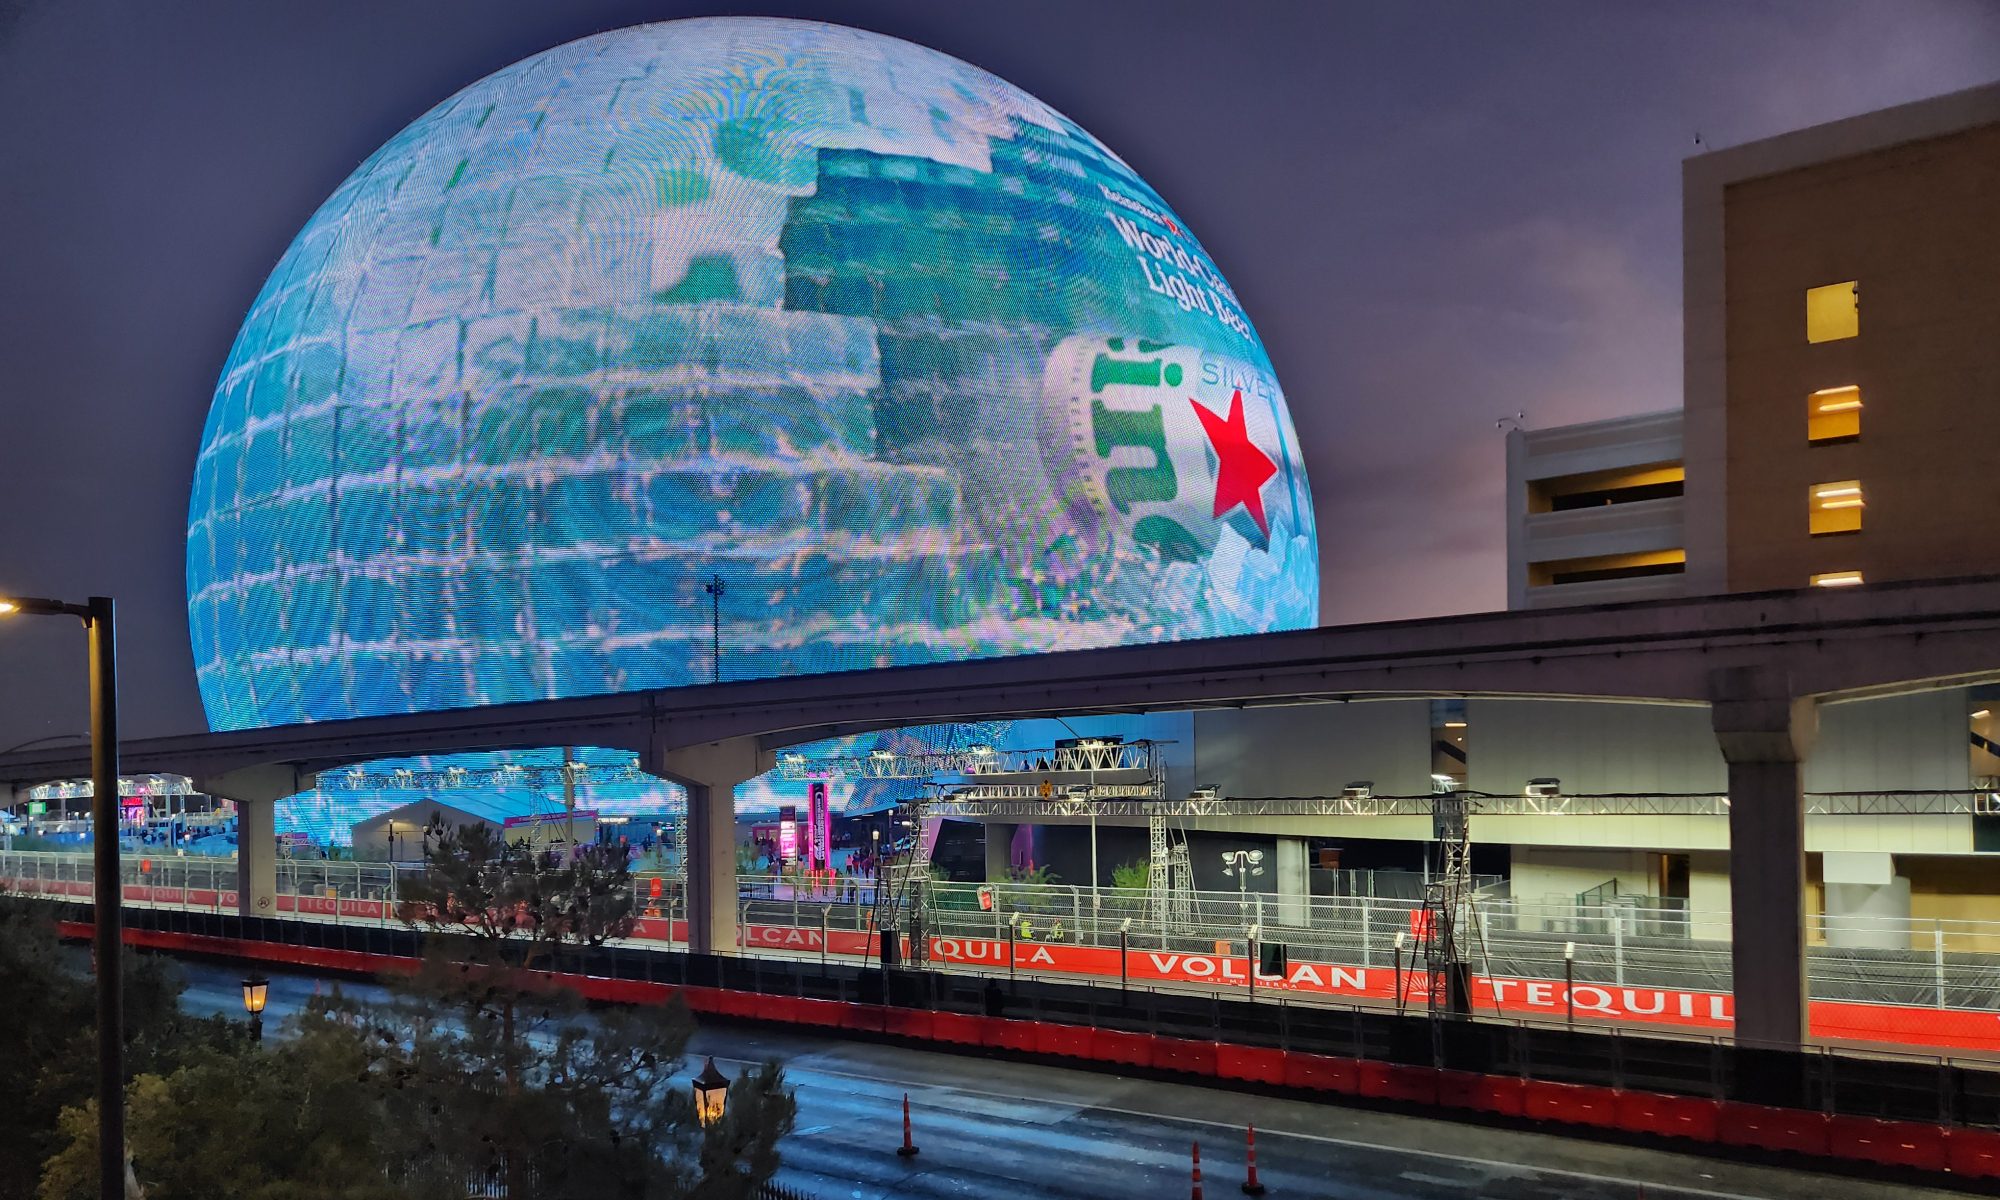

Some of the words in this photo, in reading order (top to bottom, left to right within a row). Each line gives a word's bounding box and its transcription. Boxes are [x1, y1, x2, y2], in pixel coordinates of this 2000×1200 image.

[1105, 210, 1242, 312] World-C
[1137, 255, 1213, 312] Light
[1202, 363, 1276, 399] SILVER
[141, 886, 196, 903] TQUIA
[307, 899, 378, 914] TEQUILA
[736, 926, 823, 946] LCAN
[1259, 981, 1298, 990] IERRA
[1478, 979, 1734, 1021] TEQUIL
